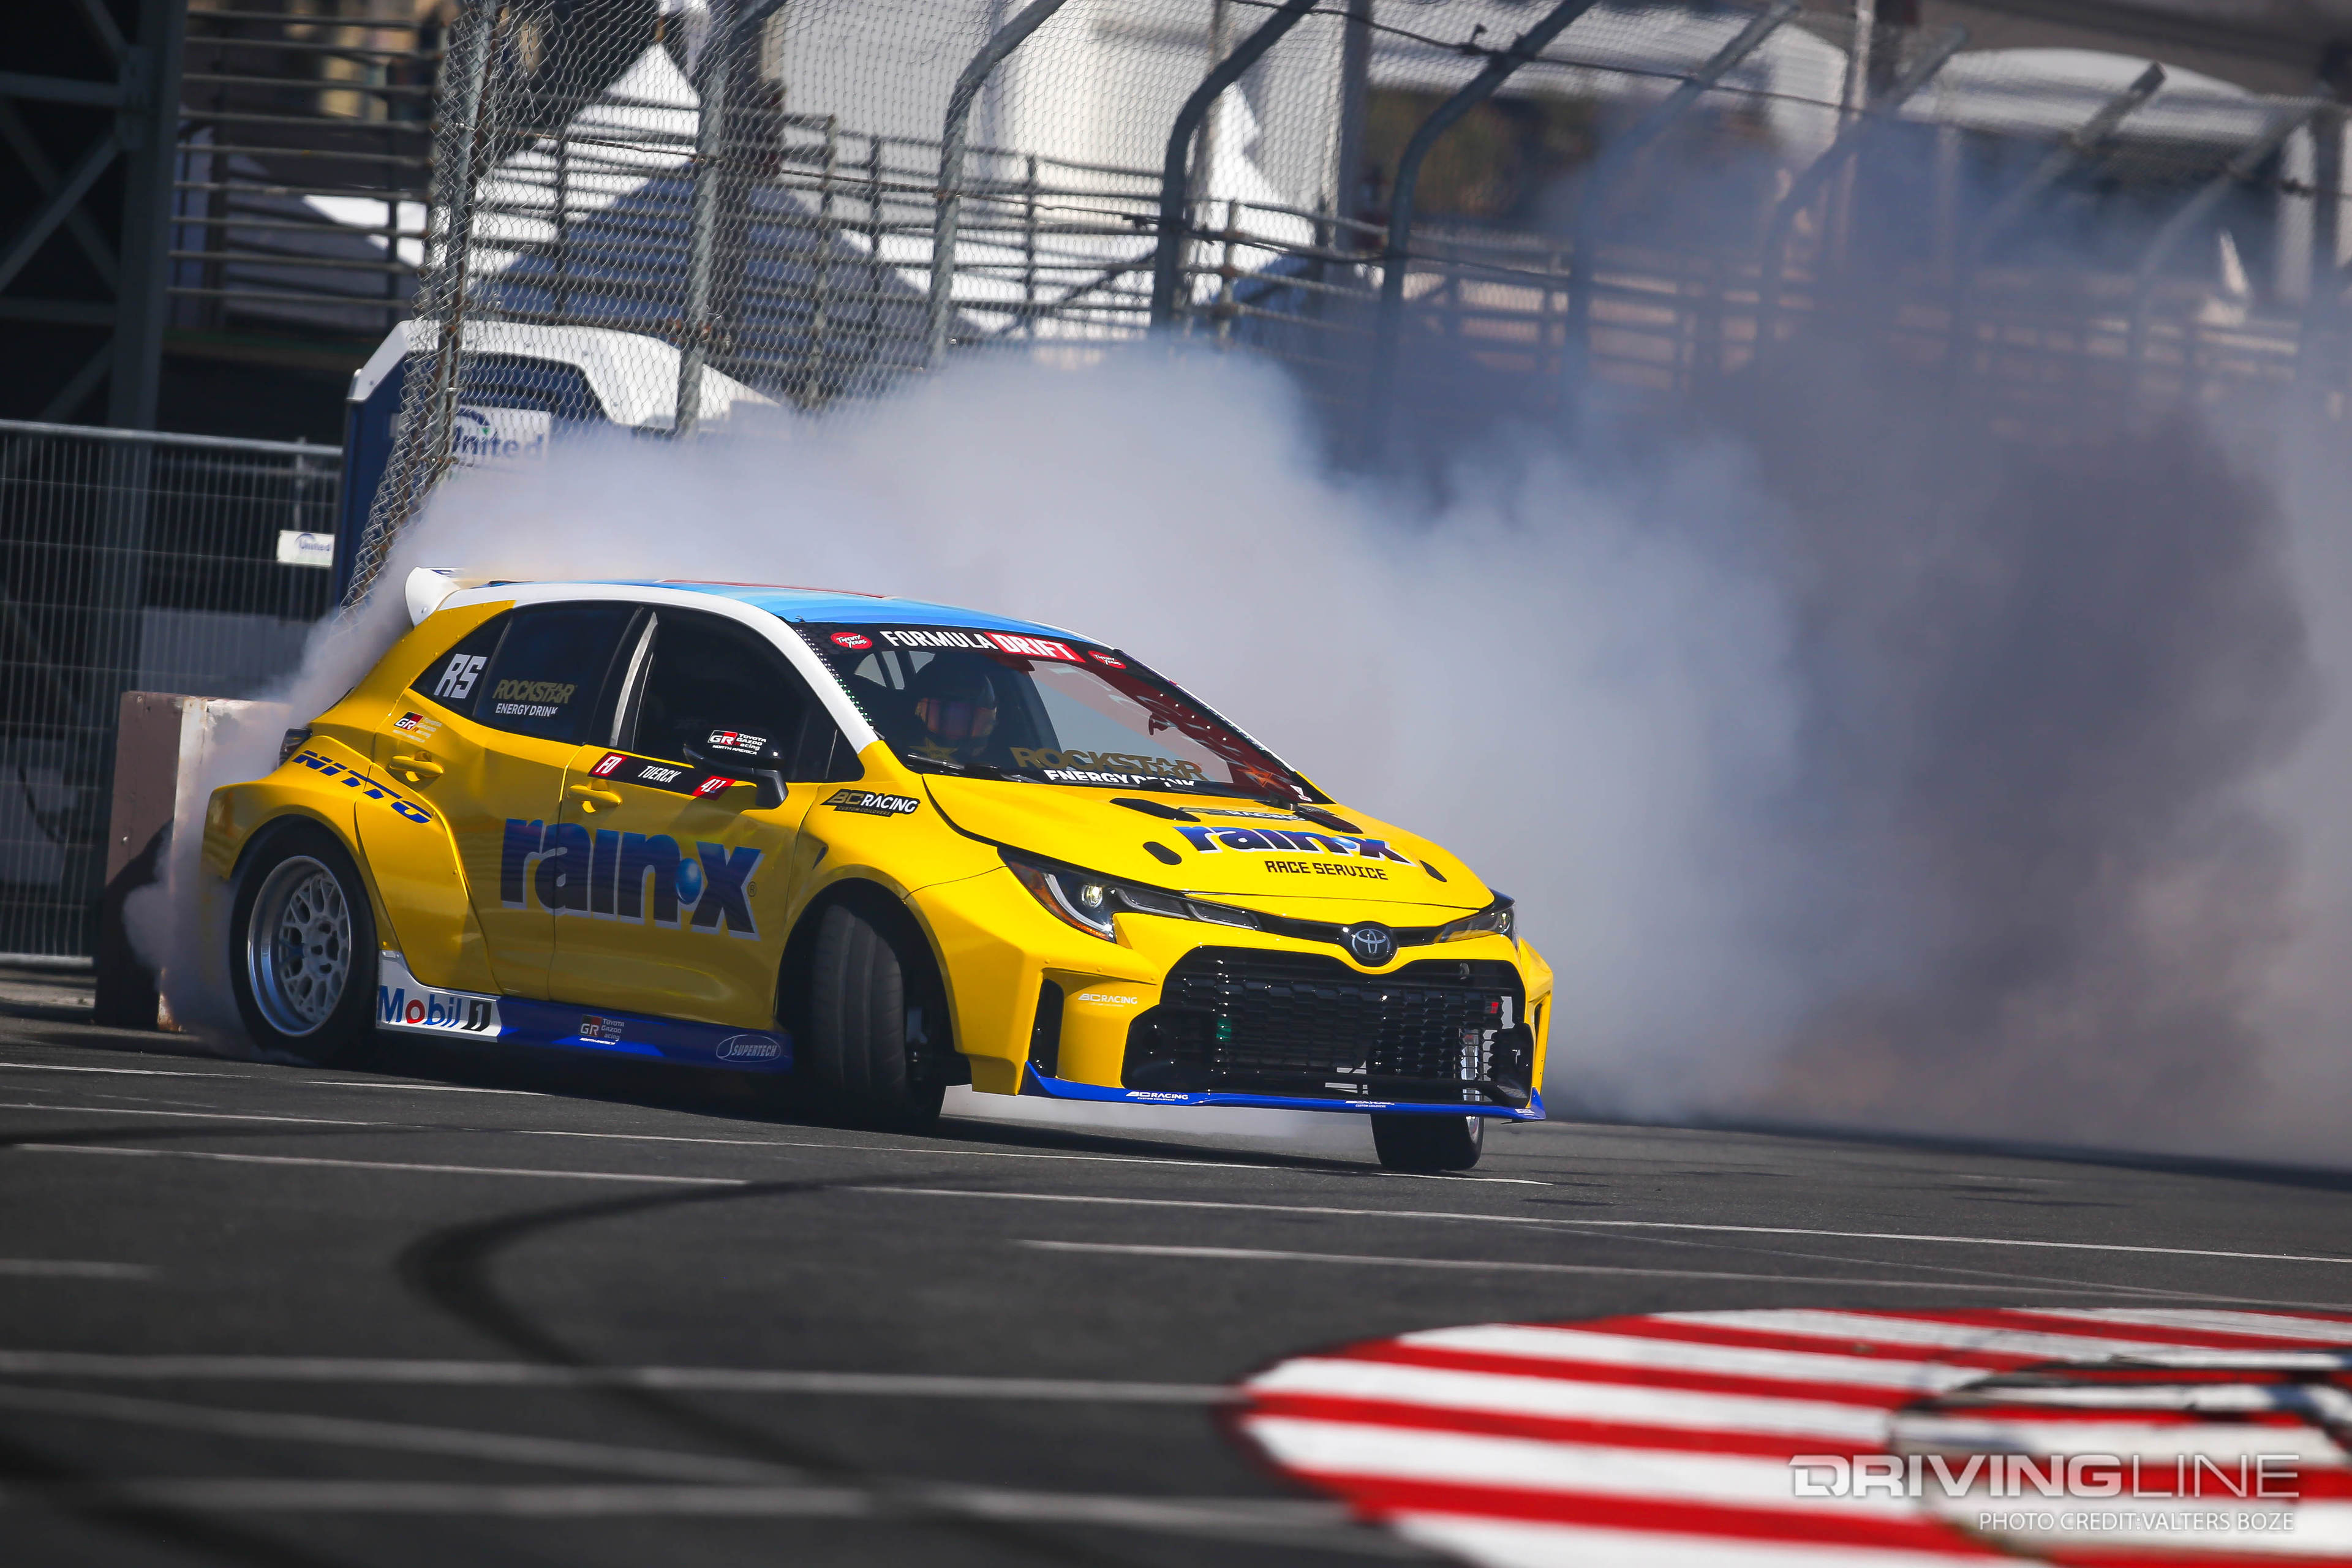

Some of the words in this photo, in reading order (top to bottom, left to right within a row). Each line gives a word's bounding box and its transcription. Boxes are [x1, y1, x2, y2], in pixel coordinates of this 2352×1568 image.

[880, 631, 998, 649] FORMULA
[990, 634, 1076, 660] DRIFT
[434, 654, 488, 699] RS
[492, 679, 575, 704] ROCKSTAR
[496, 703, 530, 715] ENERGY
[394, 718, 417, 730] GR
[709, 735, 734, 745] GR
[736, 737, 763, 746] GAZOO
[739, 733, 767, 742] TOYOTA
[595, 756, 622, 774] FD
[1010, 747, 1208, 781] ROCKSTAR
[638, 765, 682, 783] TUERCK
[1043, 769, 1129, 783] ENERGY
[1131, 774, 1194, 788] DINK
[292, 750, 432, 823] NITTO
[1264, 861, 1311, 874] RACE
[1315, 862, 1389, 880] SERVICE
[377, 985, 462, 1028] Mobil
[580, 1023, 599, 1036] GR
[731, 1044, 777, 1057] SUPERTECH
